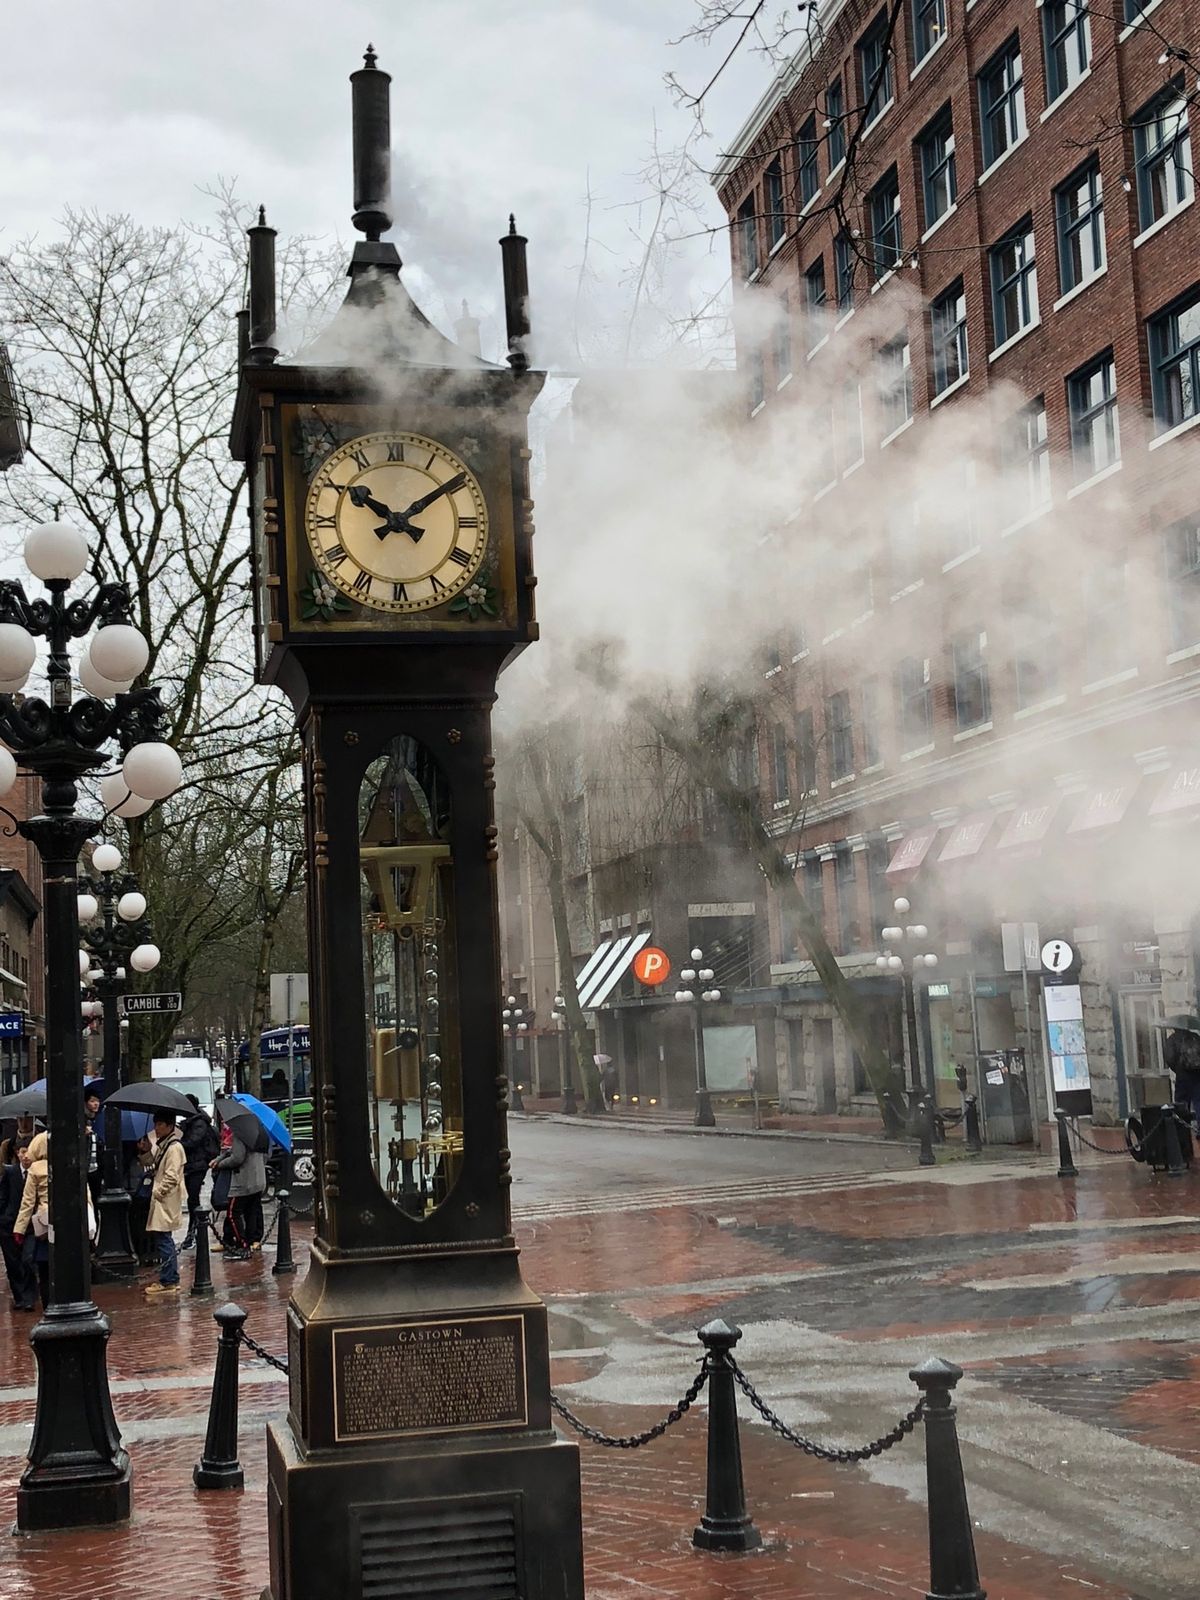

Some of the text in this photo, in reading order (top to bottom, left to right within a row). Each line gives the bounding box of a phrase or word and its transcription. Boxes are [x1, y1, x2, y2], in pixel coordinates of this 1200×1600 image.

[643, 953, 663, 979] P
[127, 997, 161, 1010] CAMBIE
[398, 1328, 463, 1341] GASTOWN
